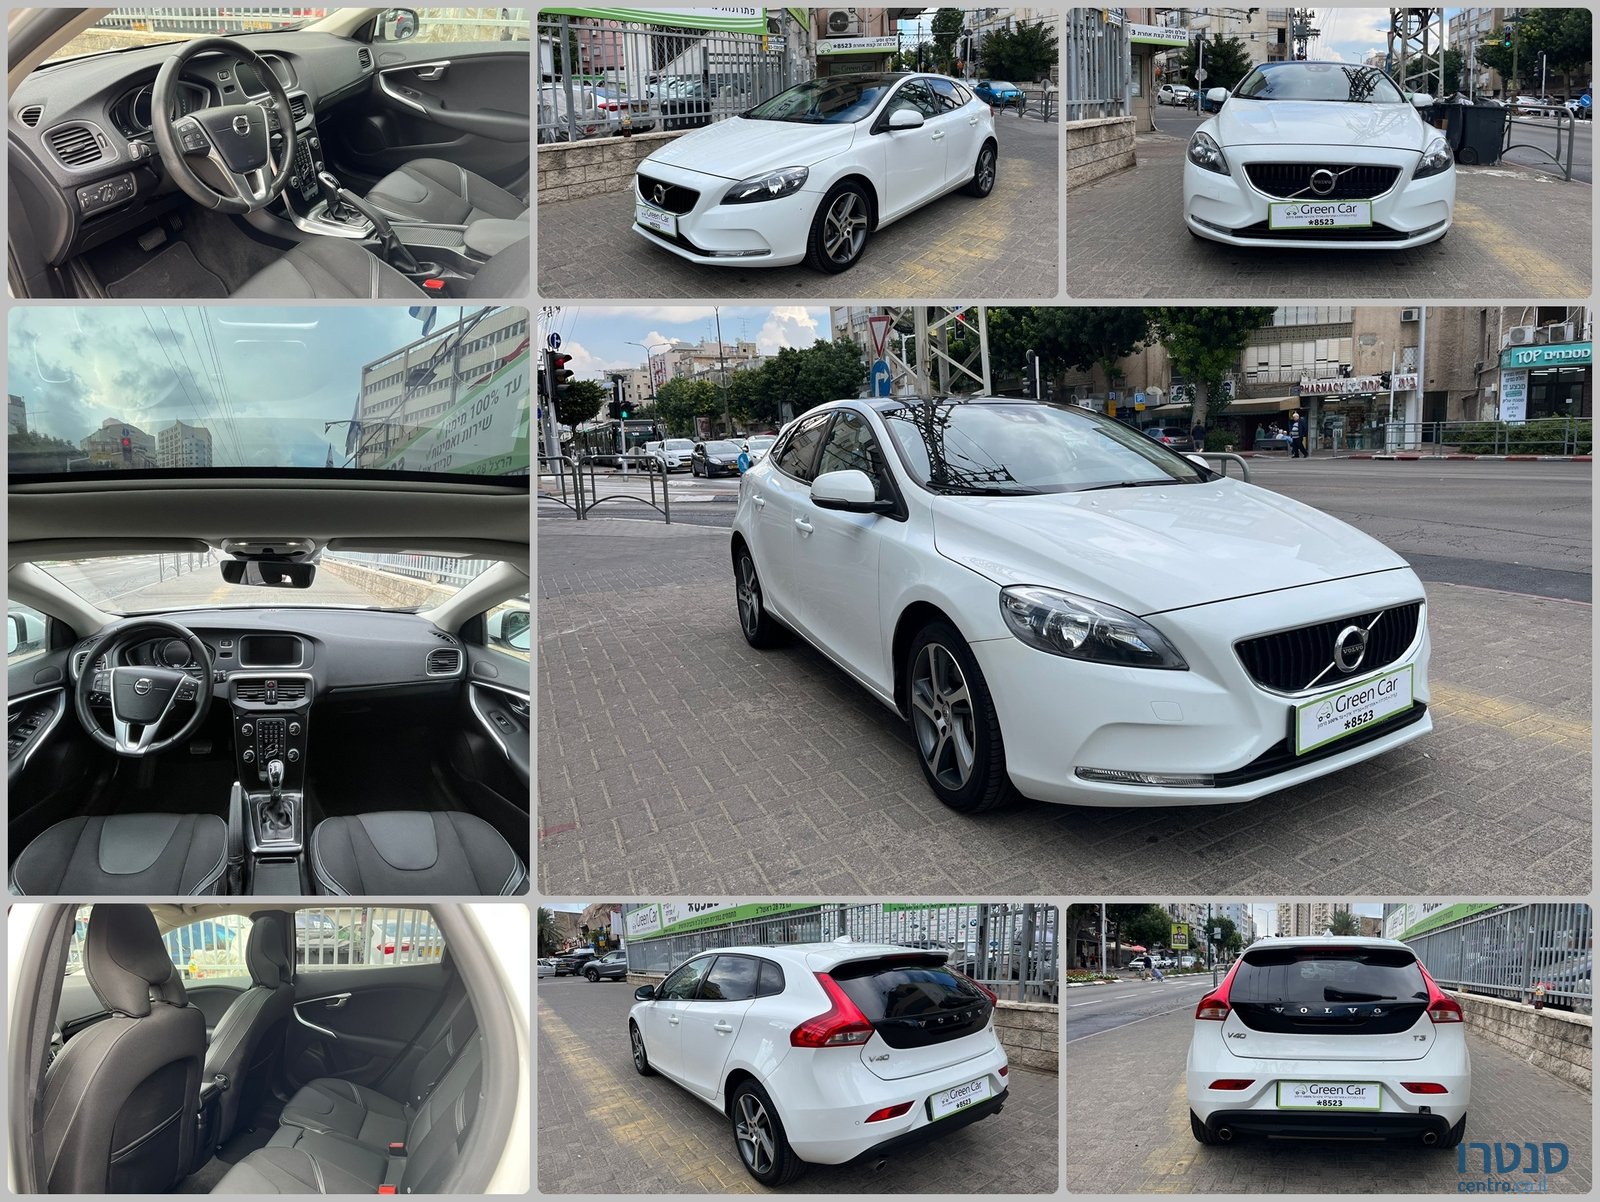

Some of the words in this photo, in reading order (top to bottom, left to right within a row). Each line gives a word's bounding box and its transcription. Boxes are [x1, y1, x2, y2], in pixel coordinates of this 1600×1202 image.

[1300, 204, 1336, 215] Green
[1337, 203, 1357, 214] Car
[1516, 349, 1542, 364] TOP
[504, 374, 523, 398] עד
[1300, 382, 1345, 394] PHARMACY
[470, 390, 500, 419] 100%
[445, 412, 467, 439] מימון
[462, 414, 493, 441] שירות
[431, 434, 461, 459] ואמינות
[1343, 645, 1364, 654] VOLVO
[1335, 688, 1375, 713] Green
[1377, 677, 1398, 696] Car
[636, 912, 649, 927] Green
[649, 907, 658, 923] Car
[1274, 1006, 1382, 1014] VOLVO
[1227, 1032, 1247, 1040] V40
[1413, 1034, 1427, 1042] T3
[868, 1053, 890, 1063] V40
[949, 1086, 971, 1100] Green
[970, 1080, 982, 1094] Car
[1309, 1083, 1344, 1096] Green
[1346, 1083, 1367, 1096] Car
